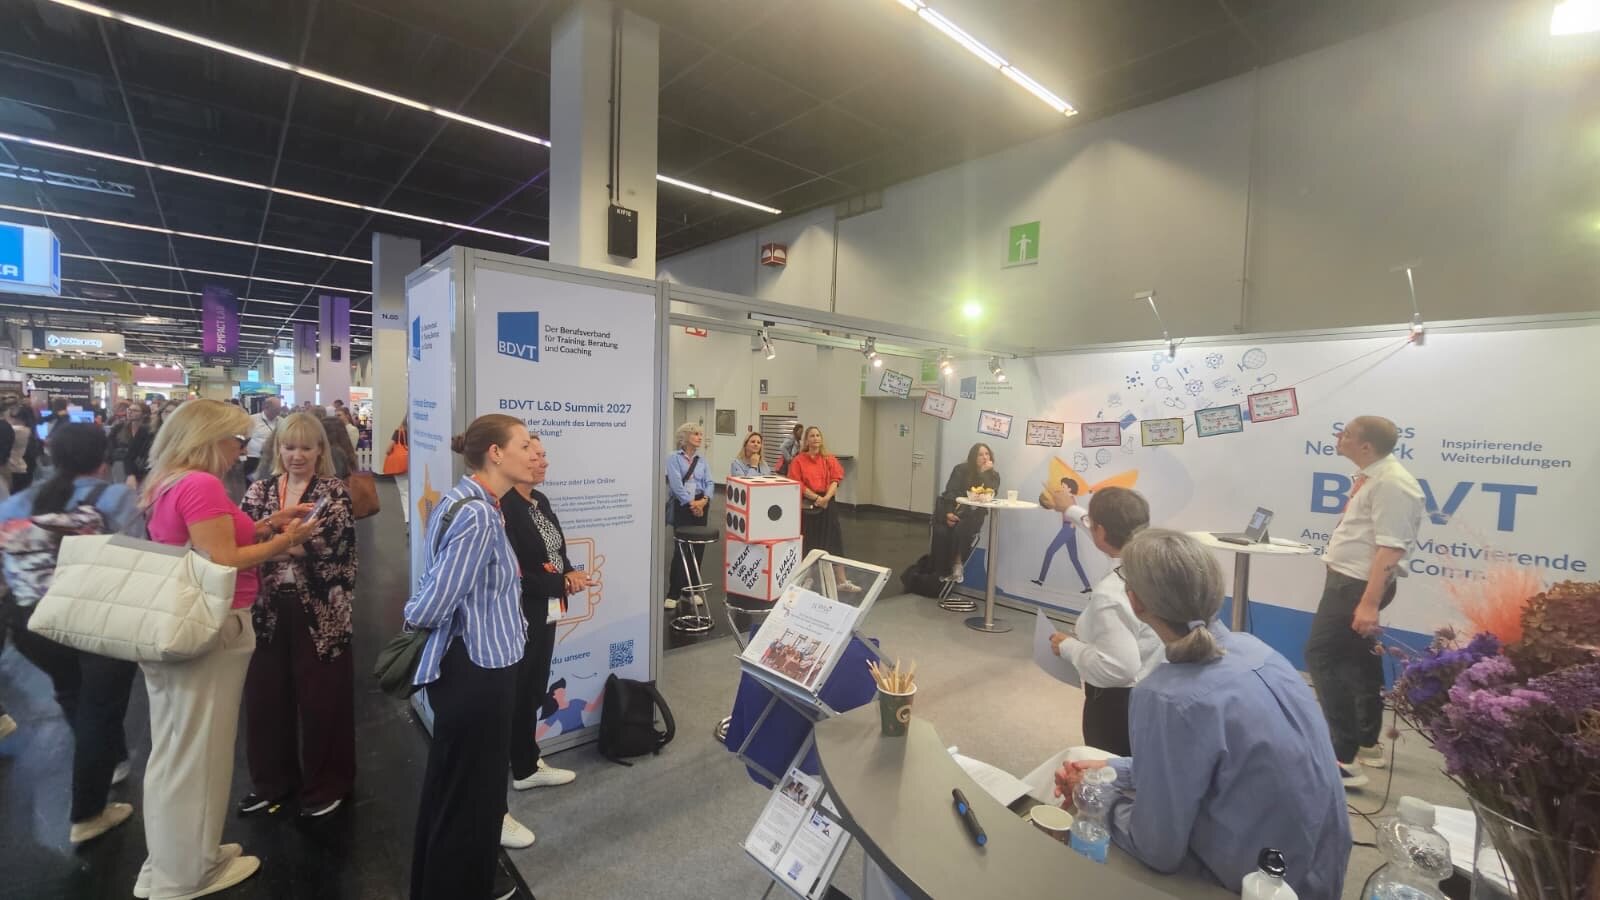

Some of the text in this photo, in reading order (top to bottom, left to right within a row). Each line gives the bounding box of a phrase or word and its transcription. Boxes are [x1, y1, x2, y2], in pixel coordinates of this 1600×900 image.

[544, 325, 611, 339] Der Berufsverband
[544, 335, 556, 343] für
[588, 339, 619, 350] Beratung
[499, 341, 537, 359] BDVT
[544, 345, 592, 357] und Coaching
[499, 399, 632, 414] BDVT L&D Summit 2027
[528, 418, 540, 426] der
[542, 418, 571, 427] Zukunft
[572, 419, 585, 427] des
[613, 420, 627, 428] und
[1440, 439, 1543, 452] Inspirierende
[1440, 452, 1571, 469] Weiterbildungen
[1310, 471, 1538, 532] BVT
[551, 651, 591, 665] du unsere
